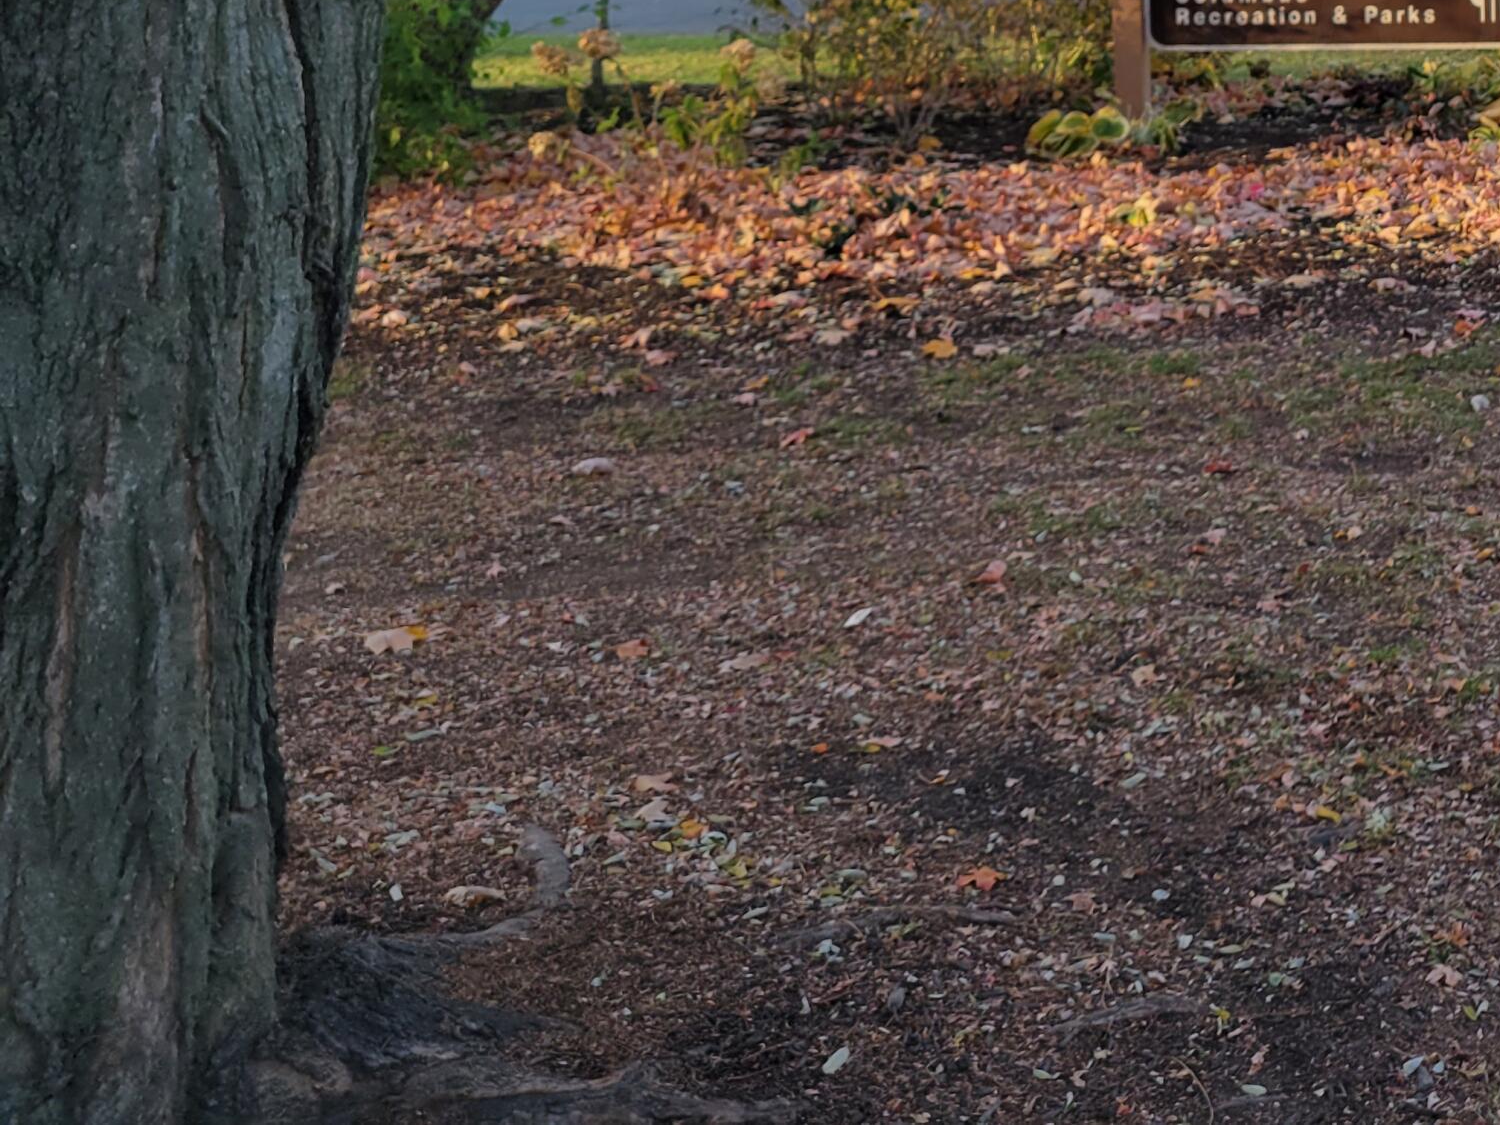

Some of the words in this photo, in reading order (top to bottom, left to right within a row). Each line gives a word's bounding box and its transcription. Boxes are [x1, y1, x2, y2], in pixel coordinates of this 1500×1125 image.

[1175, 5, 1317, 26] Recreation
[1331, 4, 1348, 25] &
[1363, 3, 1437, 25] Parks
